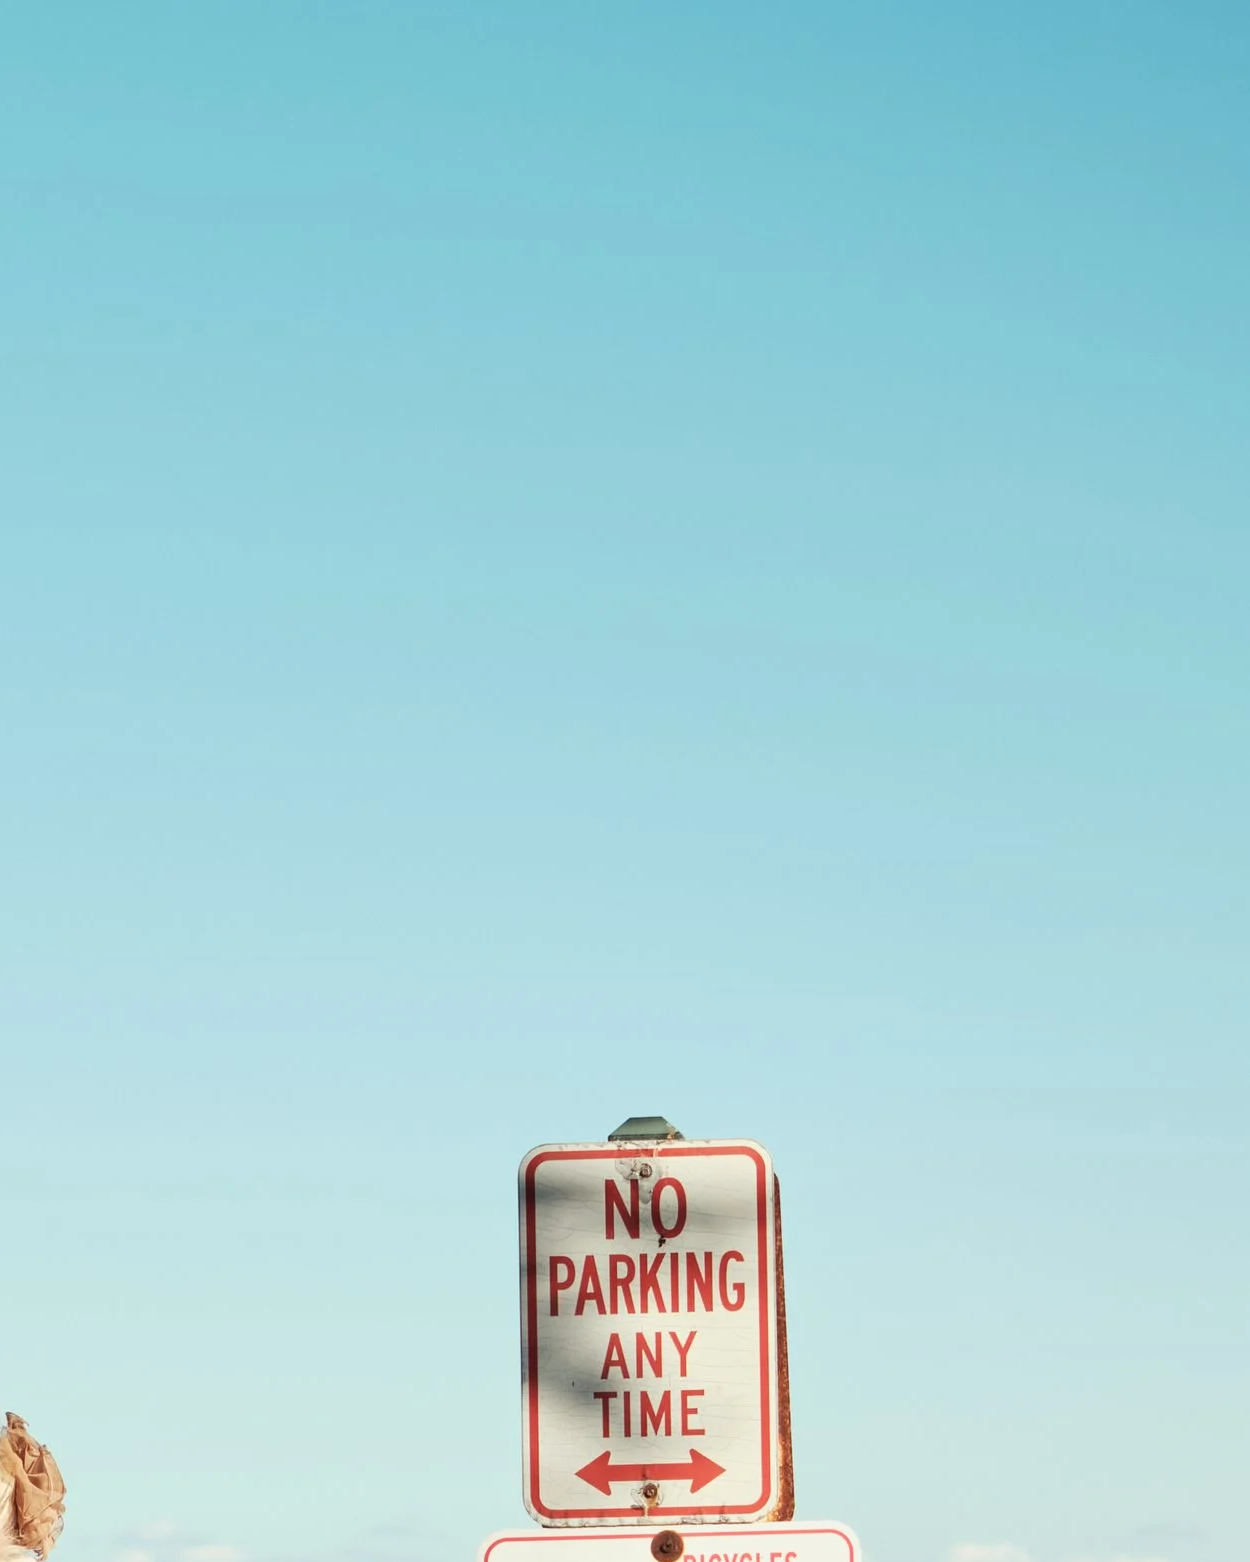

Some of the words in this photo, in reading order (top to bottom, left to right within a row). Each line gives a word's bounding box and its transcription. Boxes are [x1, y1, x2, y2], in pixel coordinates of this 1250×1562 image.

[604, 1176, 687, 1241] NO
[550, 1250, 745, 1316] PARKING
[601, 1330, 697, 1379] ANY
[594, 1389, 705, 1438] TIME
